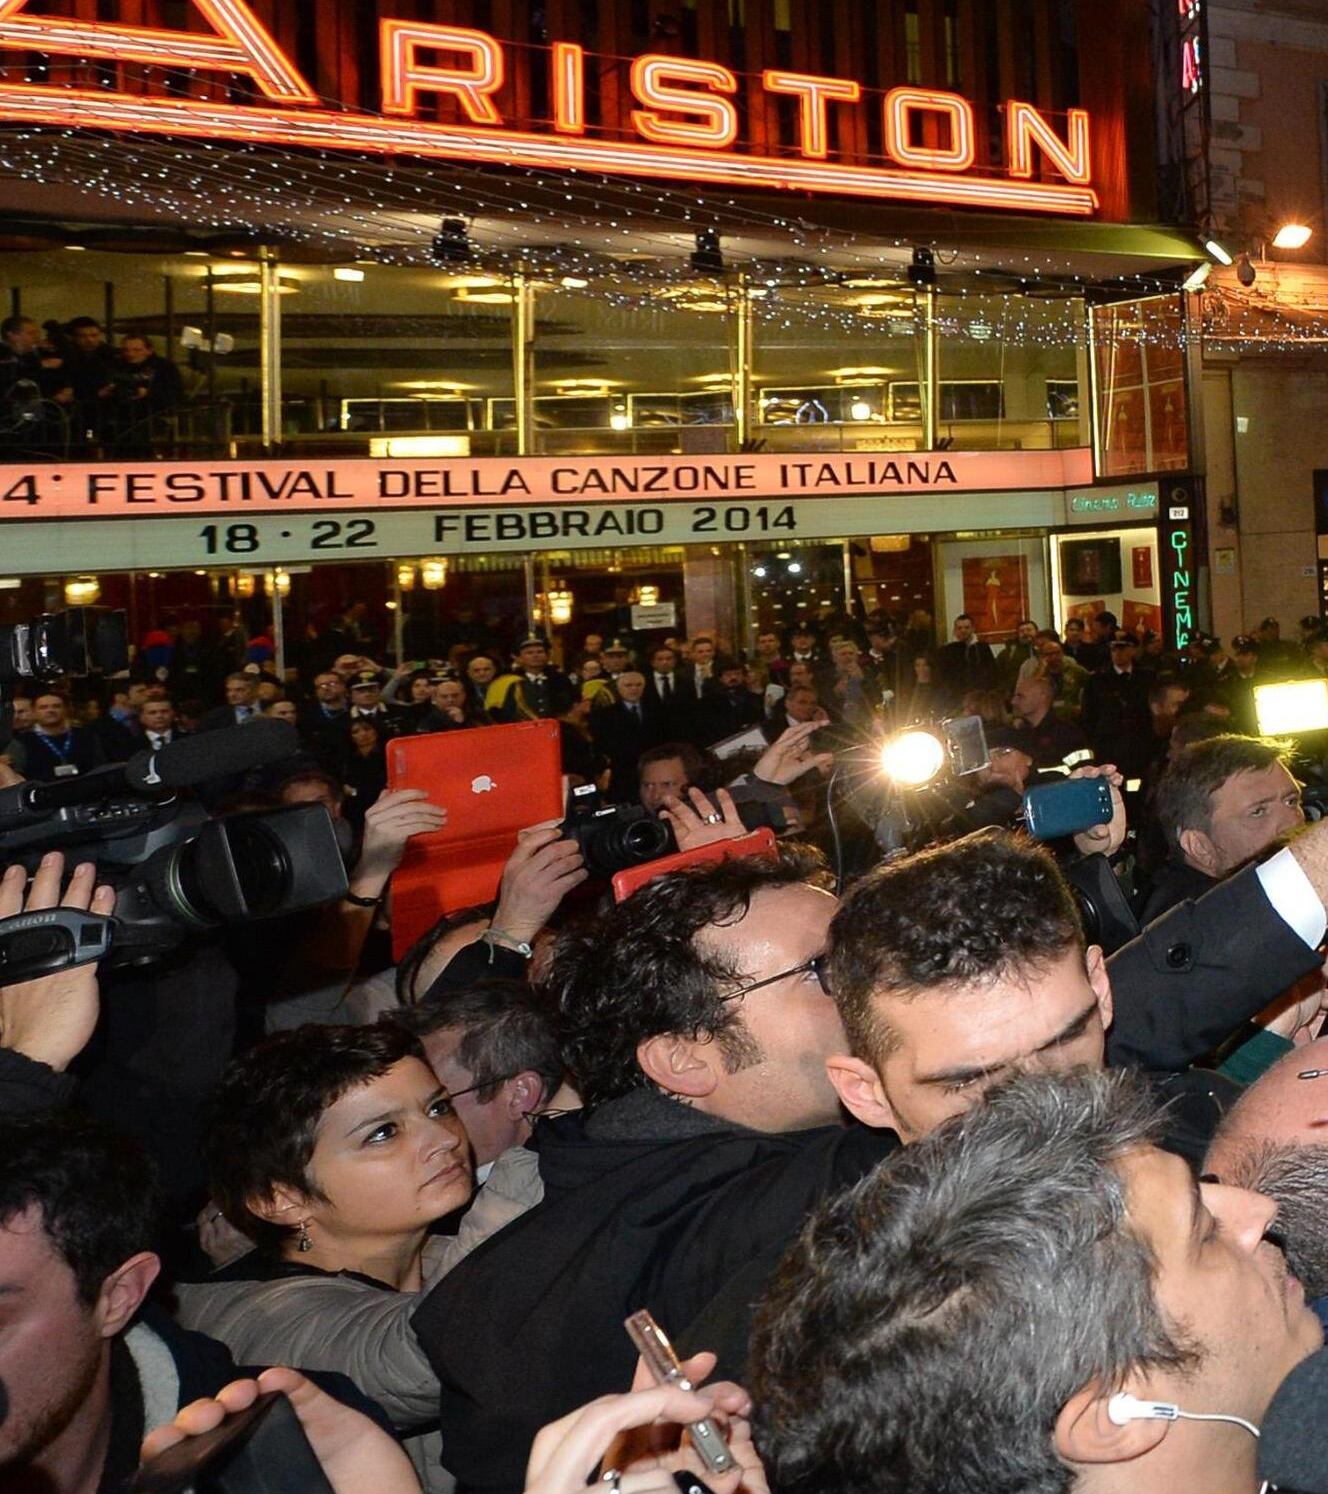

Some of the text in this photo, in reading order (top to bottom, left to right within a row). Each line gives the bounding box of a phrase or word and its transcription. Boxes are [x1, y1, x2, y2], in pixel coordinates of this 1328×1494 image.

[87, 470, 354, 504] FESTIVAL
[379, 468, 532, 498] DELLA
[550, 464, 757, 495] CANZONE
[780, 461, 958, 490] ITALIANA
[199, 524, 260, 555] 18
[310, 519, 378, 550] 22
[433, 508, 664, 542] FEBBRAIO
[691, 506, 797, 533] 2014
